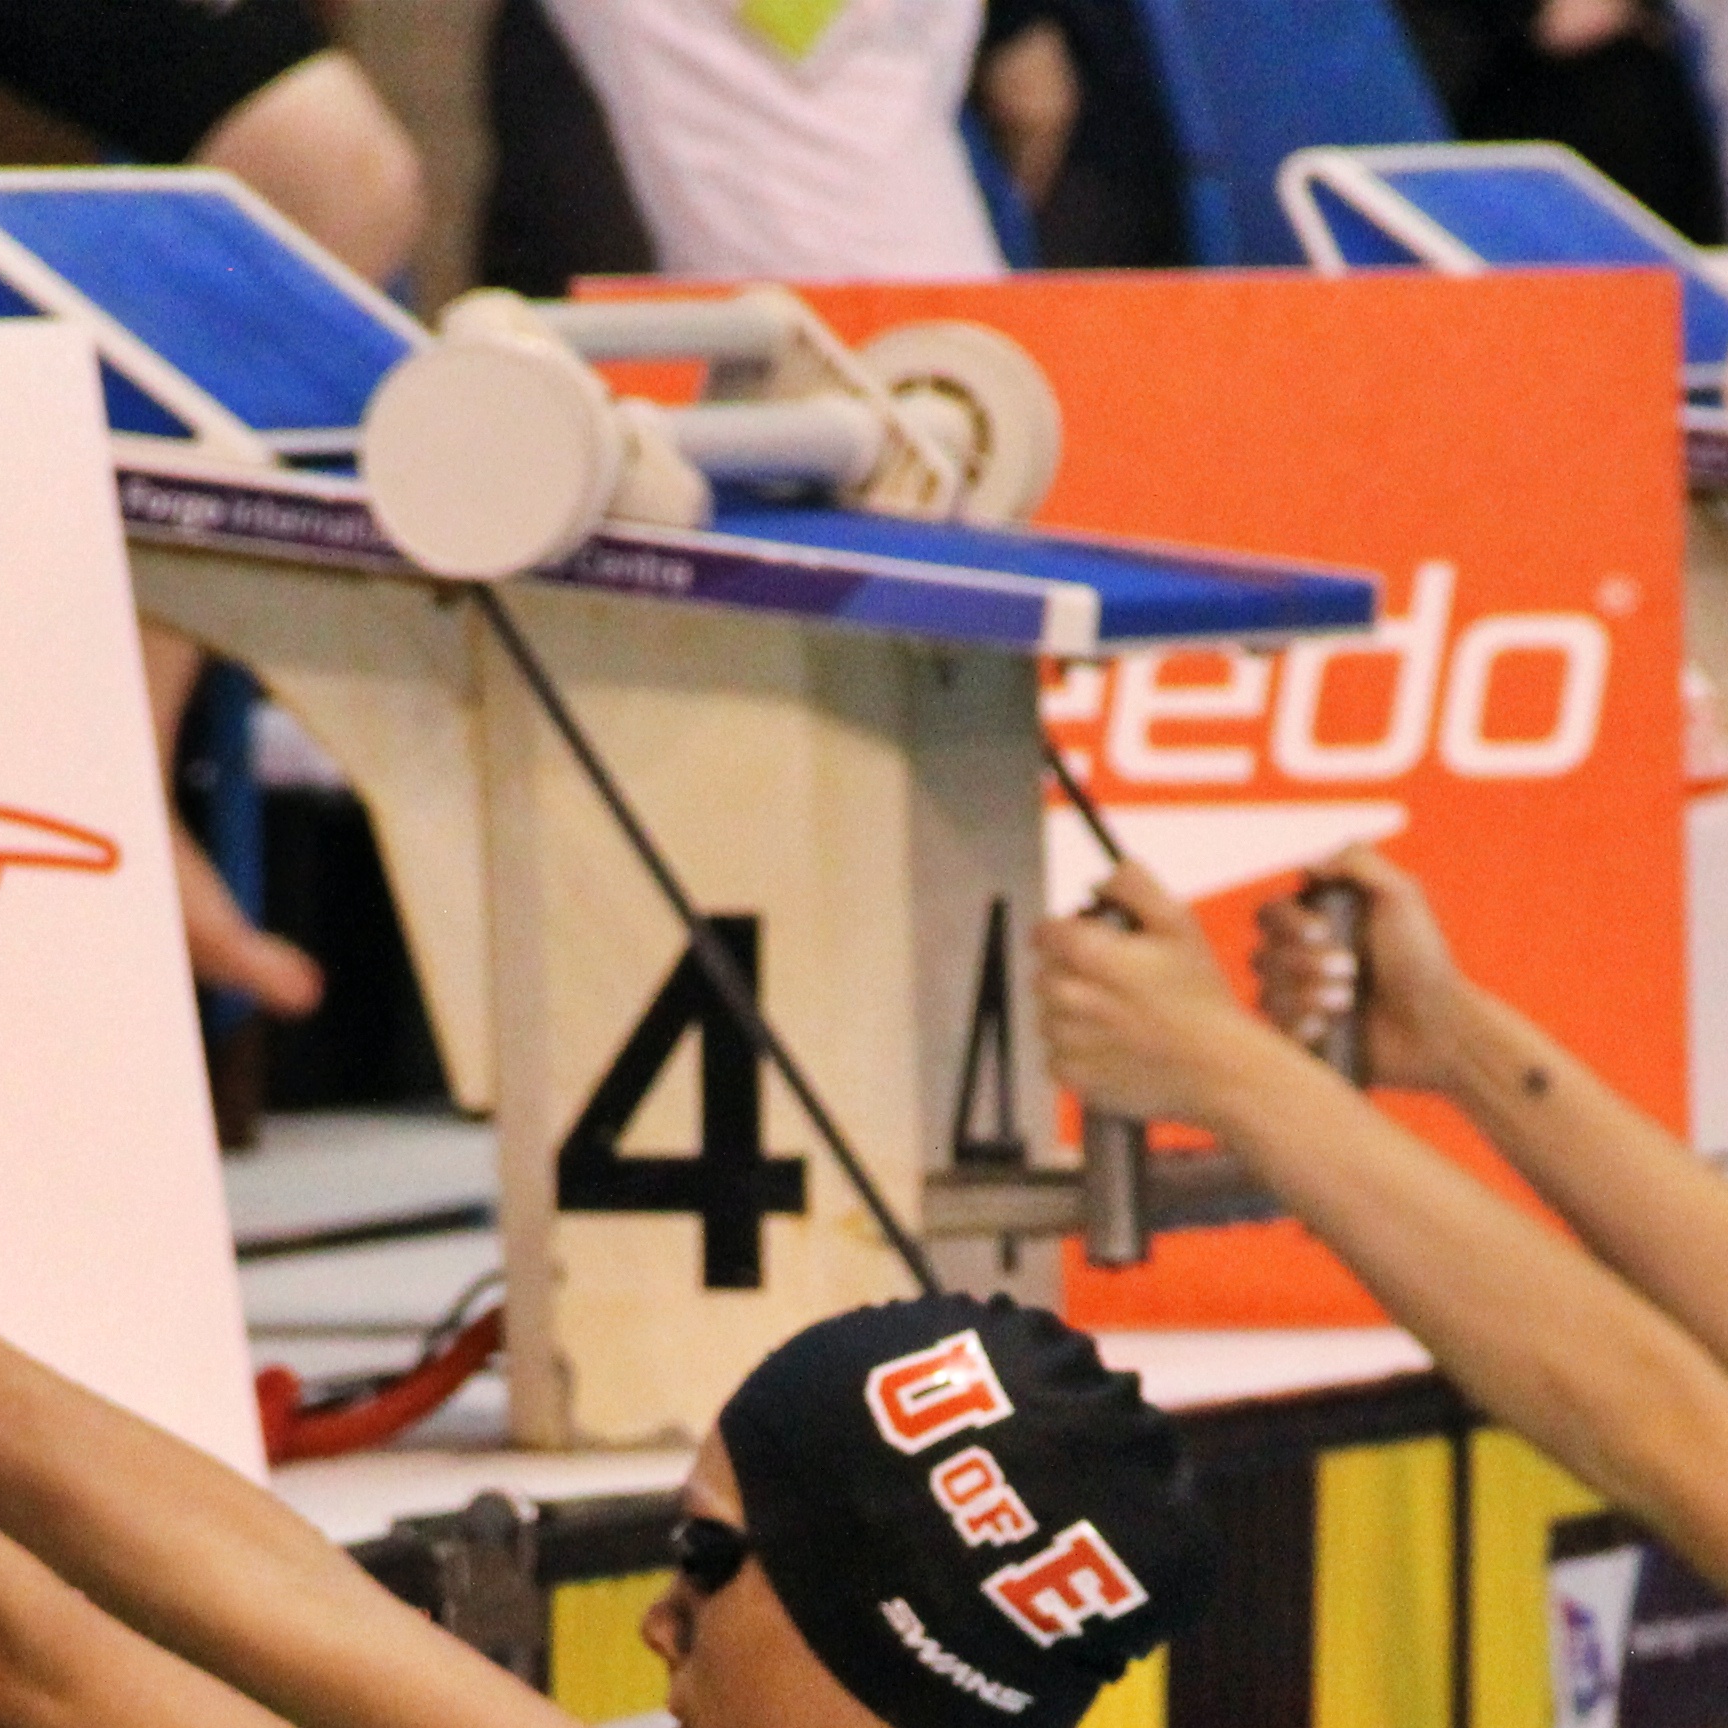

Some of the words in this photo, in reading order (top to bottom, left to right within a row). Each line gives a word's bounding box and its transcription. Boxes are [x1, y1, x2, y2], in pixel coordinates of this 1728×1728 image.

[1040, 560, 1612, 784] edo
[556, 913, 809, 1290] 4
[864, 1328, 1015, 1456] U
[929, 1445, 1039, 1548] OF
[980, 1519, 1149, 1648] E
